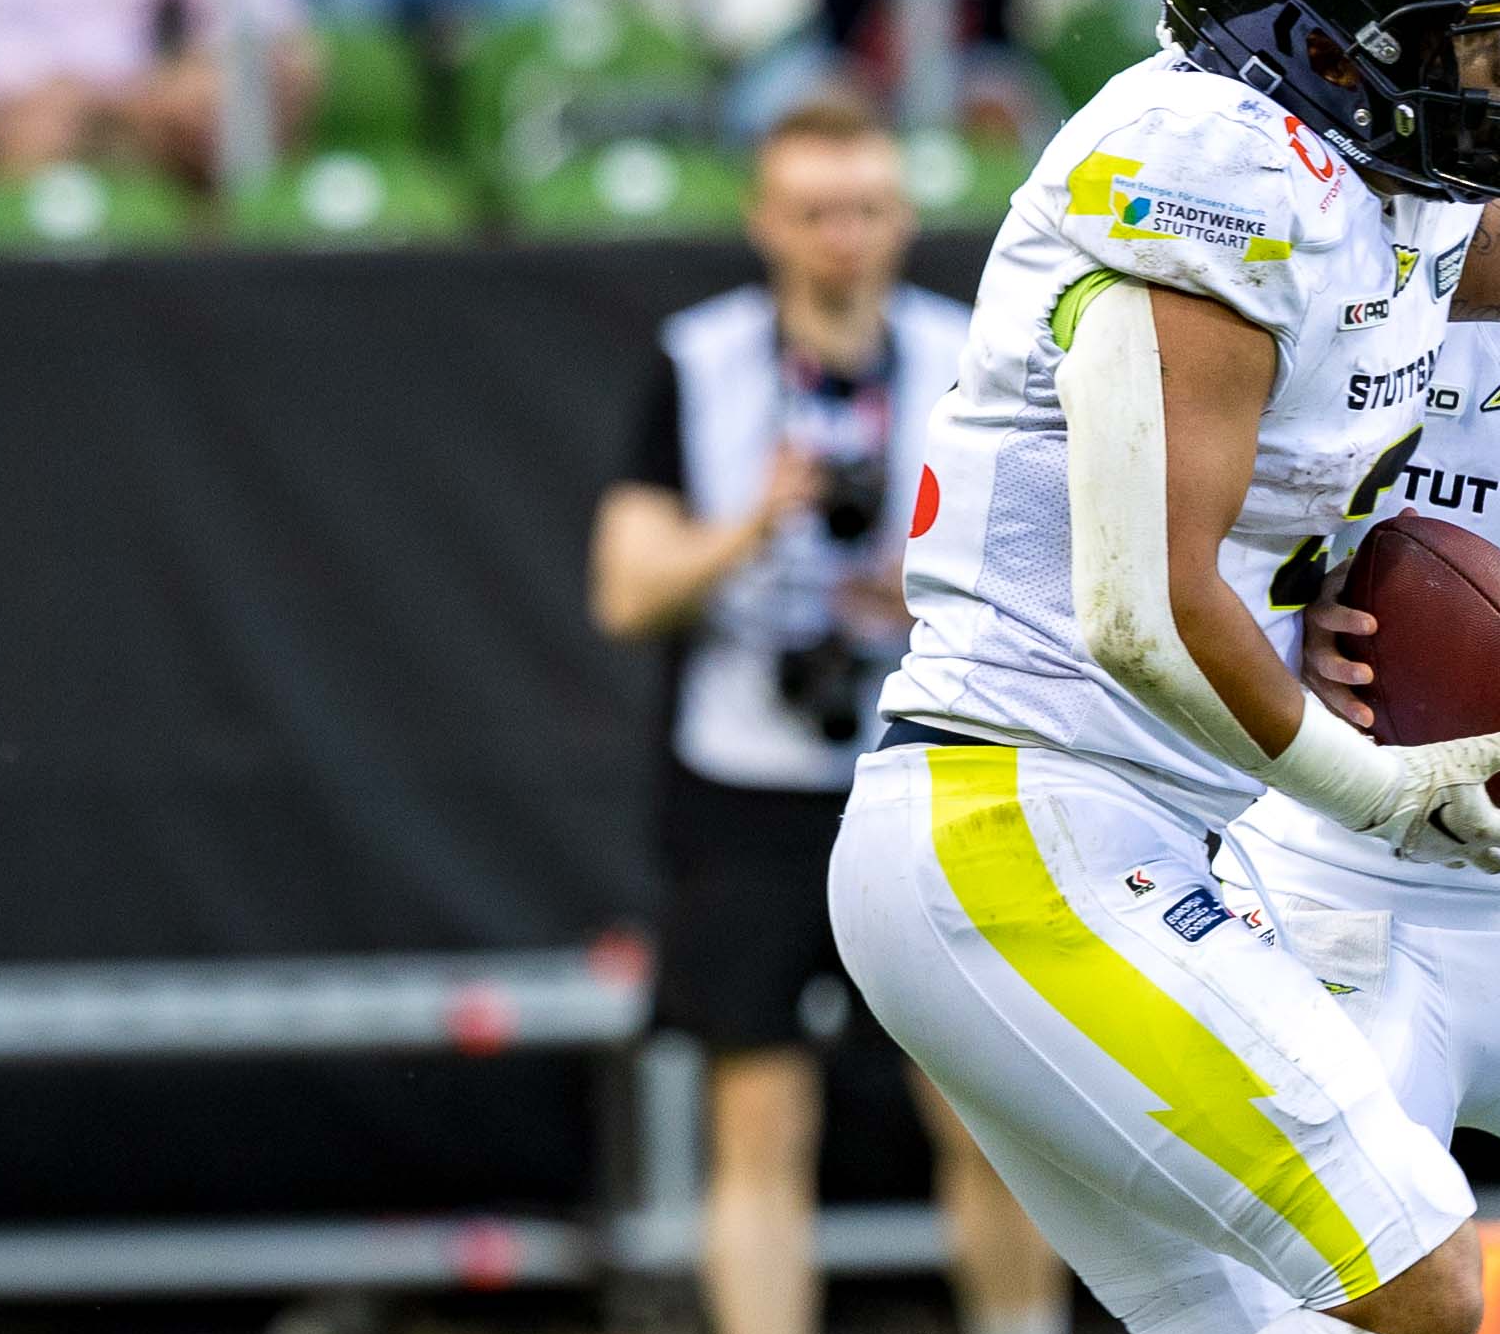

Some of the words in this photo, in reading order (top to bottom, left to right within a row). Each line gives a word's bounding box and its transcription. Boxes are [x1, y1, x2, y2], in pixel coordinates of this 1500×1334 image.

[1153, 217, 1250, 250] STUTTGART
[1156, 200, 1267, 237] STADTWERKE
[1347, 340, 1445, 411] STUTTG
